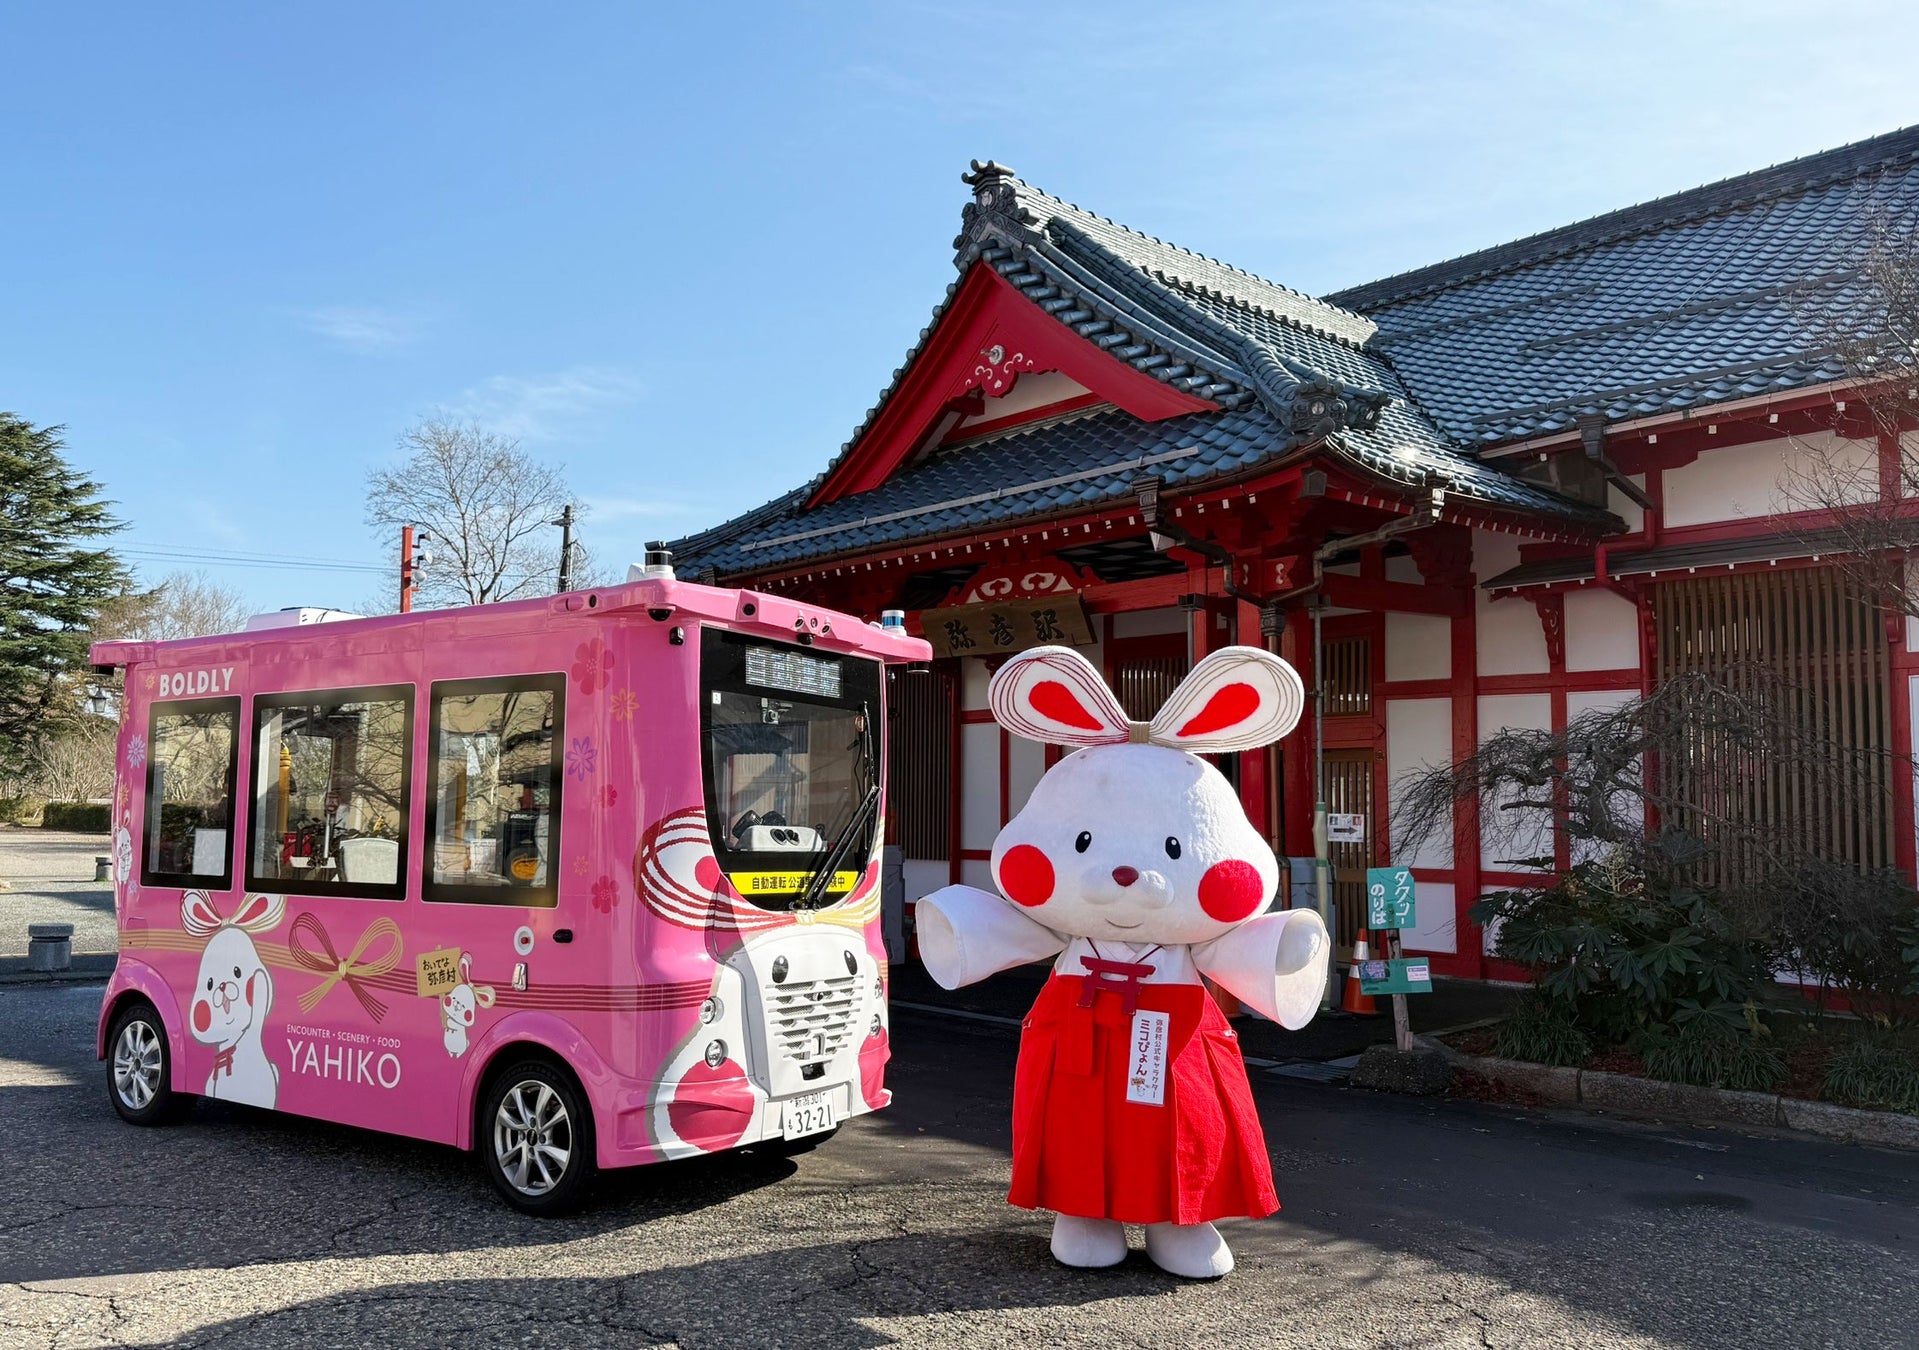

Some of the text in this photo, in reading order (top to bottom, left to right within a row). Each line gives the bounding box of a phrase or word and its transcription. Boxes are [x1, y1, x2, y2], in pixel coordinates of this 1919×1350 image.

[943, 608, 1065, 650] 弥彦駅
[159, 667, 234, 697] BOLDLY
[1394, 870, 1411, 925] タクシー
[422, 957, 450, 971] おいでよ
[427, 968, 456, 986] 弥彦村
[286, 1024, 401, 1049] ENCOUNTER SCENERY FOOD
[1136, 1018, 1151, 1077] ミコぴょん
[286, 1038, 401, 1089] YAHIKO
[1151, 1018, 1164, 1099] 弥彦村公式キャラクター
[795, 1104, 831, 1134] 32-21
